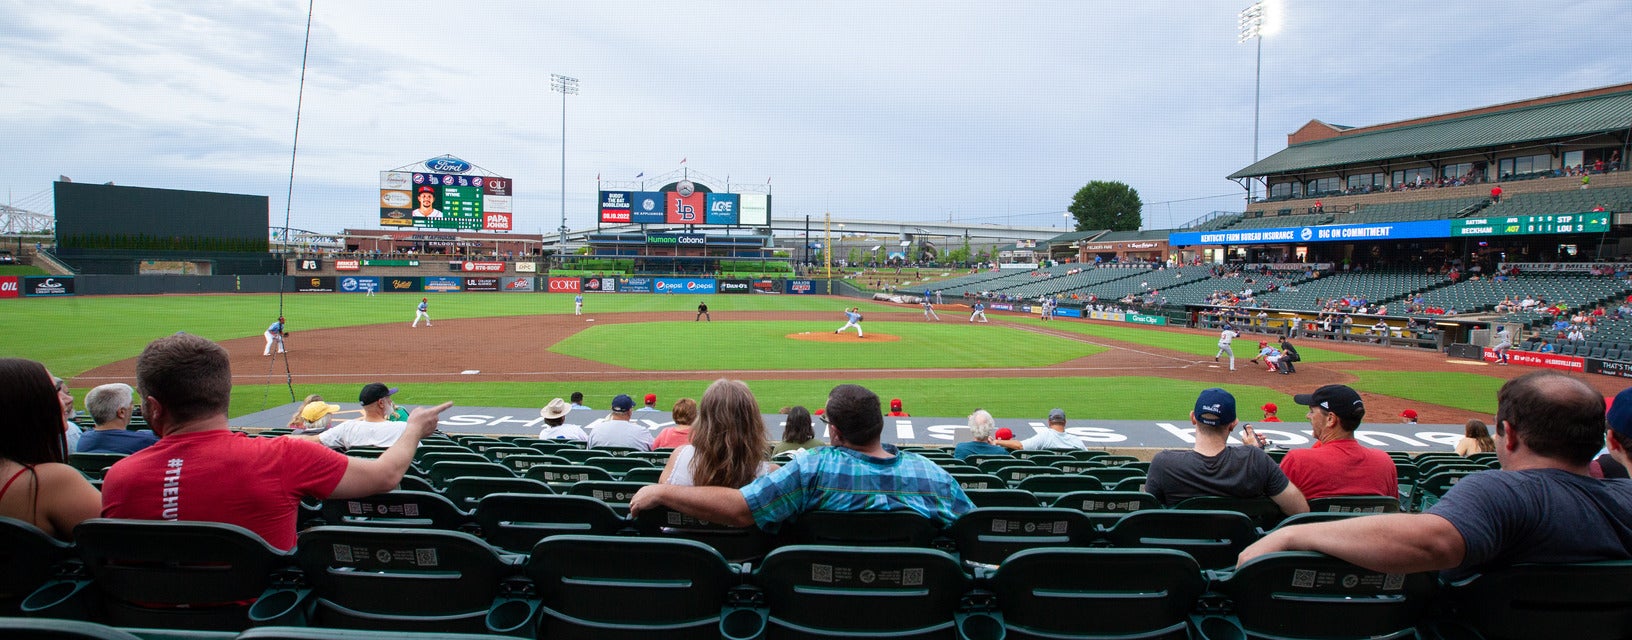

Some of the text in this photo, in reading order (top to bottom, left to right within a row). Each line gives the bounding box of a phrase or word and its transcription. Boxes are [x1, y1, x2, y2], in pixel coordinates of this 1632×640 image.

[434, 159, 463, 172] Ford
[711, 201, 733, 212] LG&E
[487, 214, 508, 223] PAPA
[1556, 215, 1573, 223] STP
[486, 221, 509, 229] JOHNS
[1461, 226, 1493, 234] BECKHAM
[1556, 224, 1573, 233] LOU
[1577, 224, 1584, 232] 3
[1201, 226, 1390, 243] KENTUCKY FARM BUREAU INSURANCE BIG ON COMMITMENT
[678, 236, 704, 244] Cabana
[1, 282, 18, 291] OIL
[550, 280, 580, 290] CORT
[1132, 315, 1158, 324] Great Clips
[1602, 361, 1624, 370] THAT'S
[162, 458, 184, 522] #THEHU
